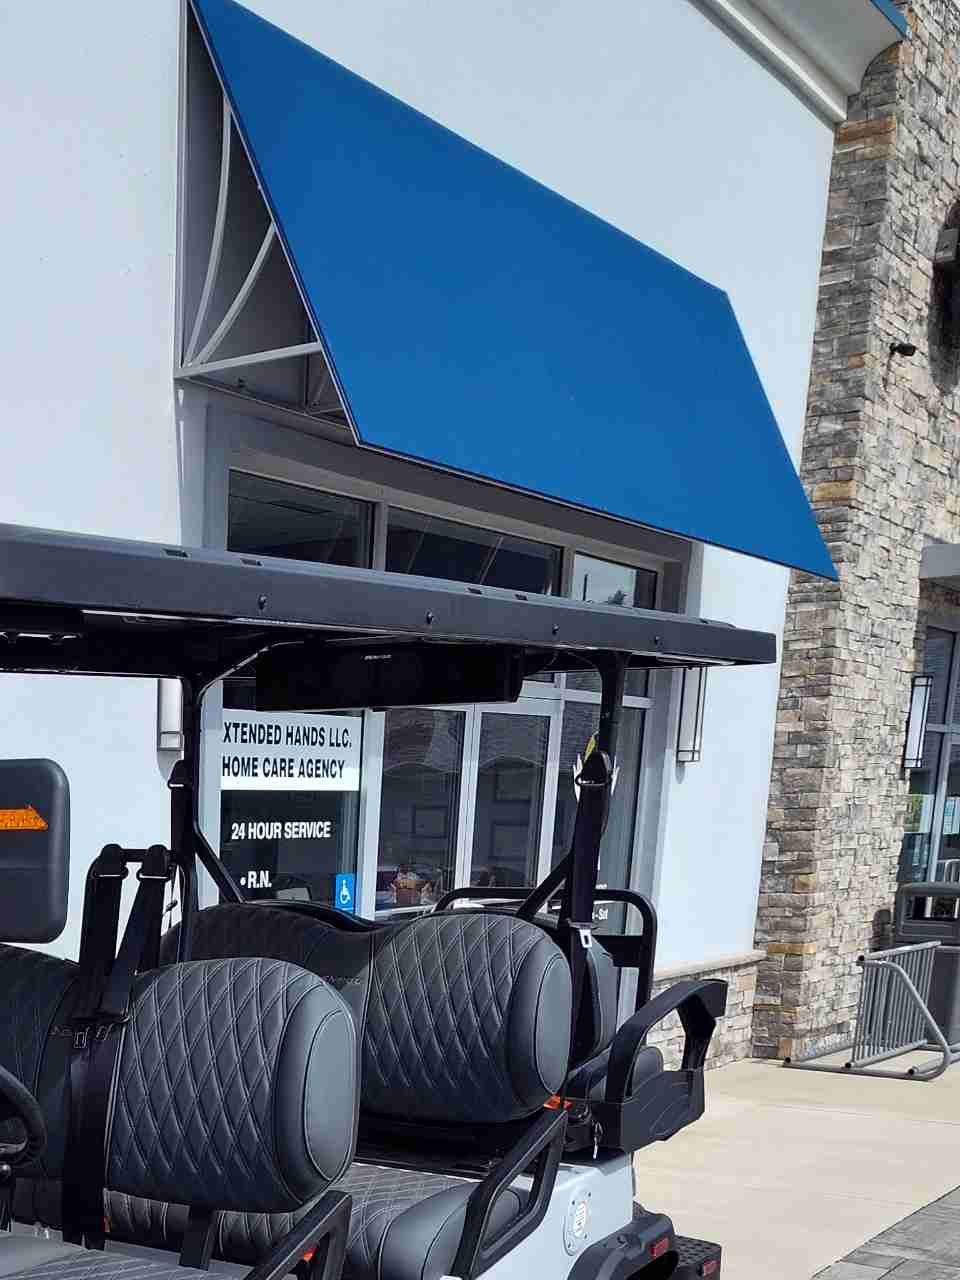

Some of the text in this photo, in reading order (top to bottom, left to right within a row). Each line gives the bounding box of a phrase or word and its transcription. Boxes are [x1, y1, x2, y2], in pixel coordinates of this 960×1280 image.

[223, 722, 352, 748] XTENDED HANDS LLC.
[222, 756, 345, 779] HOME CARE AGENCY
[231, 821, 331, 840] 24 HOUR SERVICE
